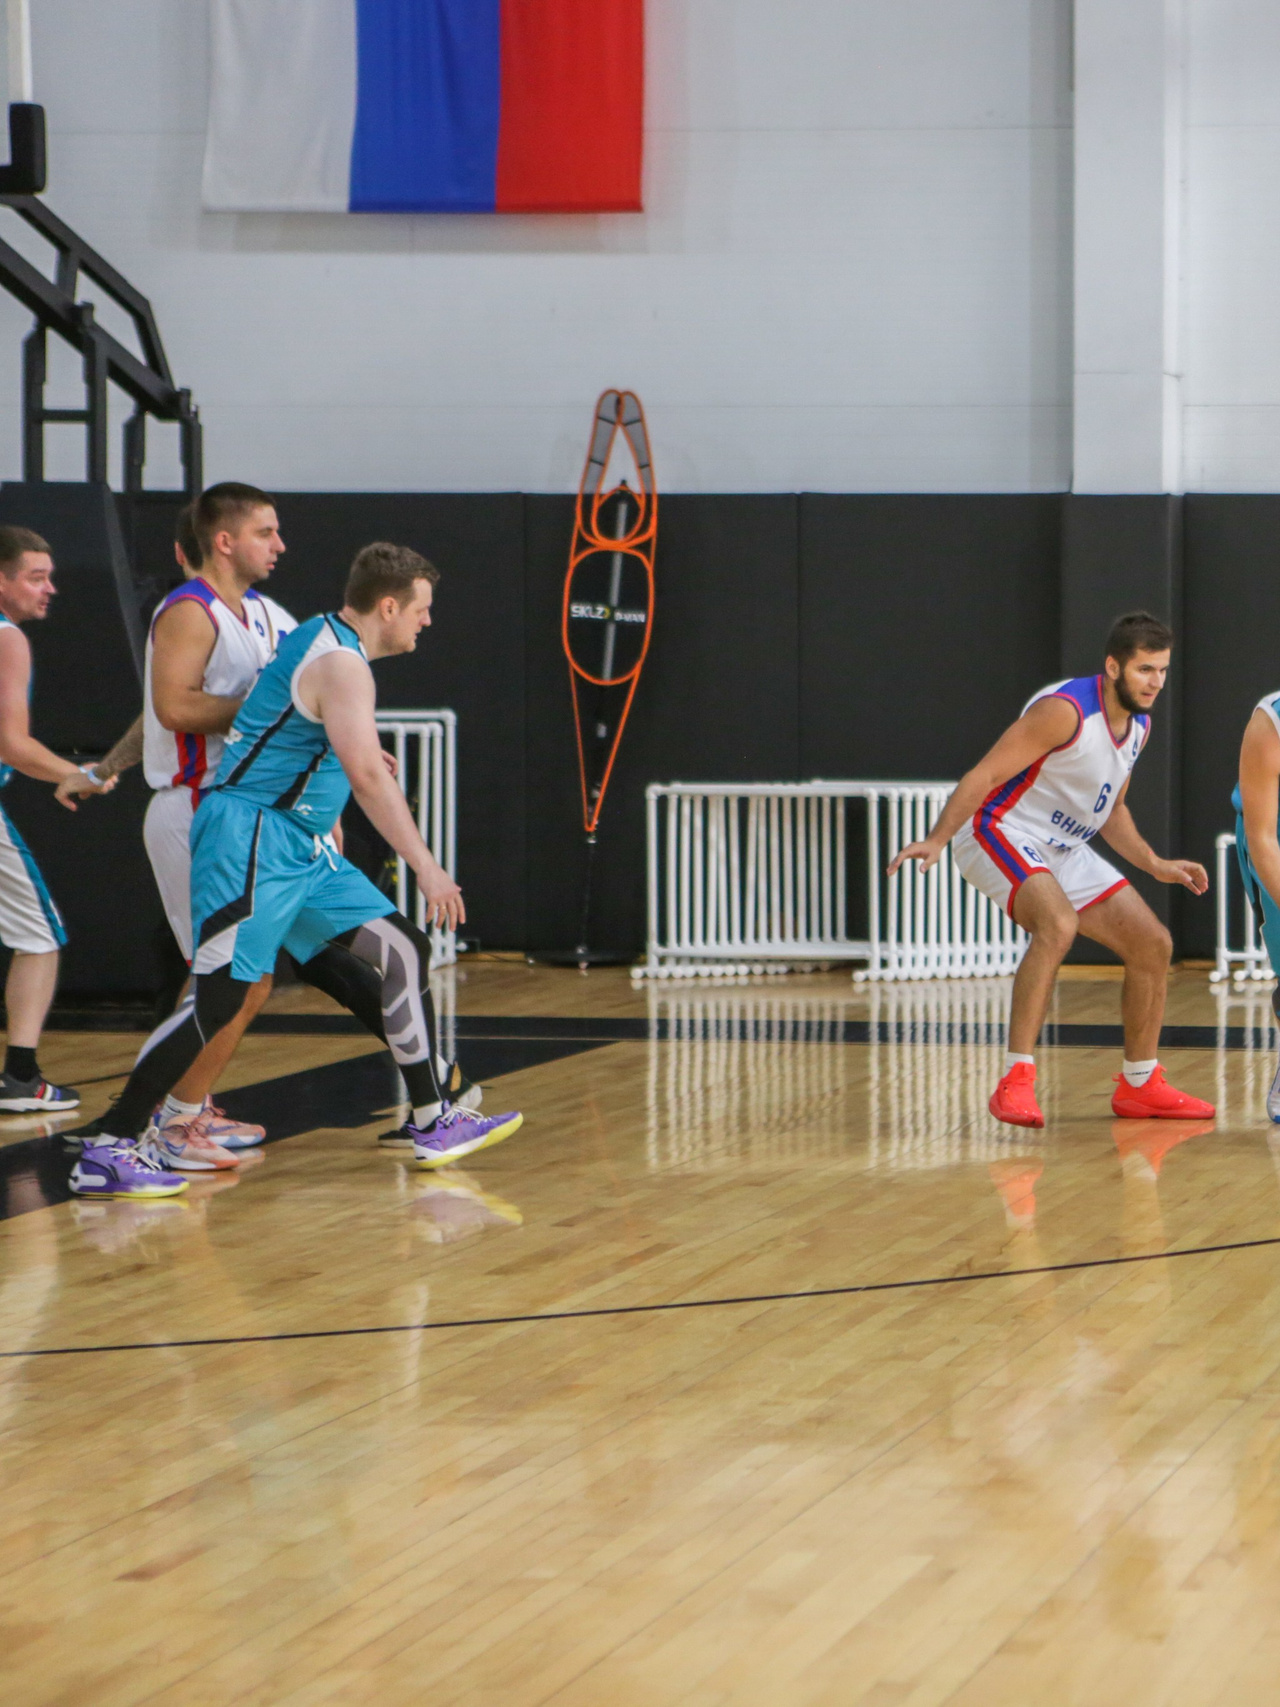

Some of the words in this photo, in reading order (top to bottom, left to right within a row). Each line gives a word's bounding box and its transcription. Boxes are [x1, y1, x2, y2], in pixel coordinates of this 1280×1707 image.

[571, 603, 605, 619] SKLZ
[1093, 783, 1112, 814] 6
[1023, 846, 1043, 863] 6
